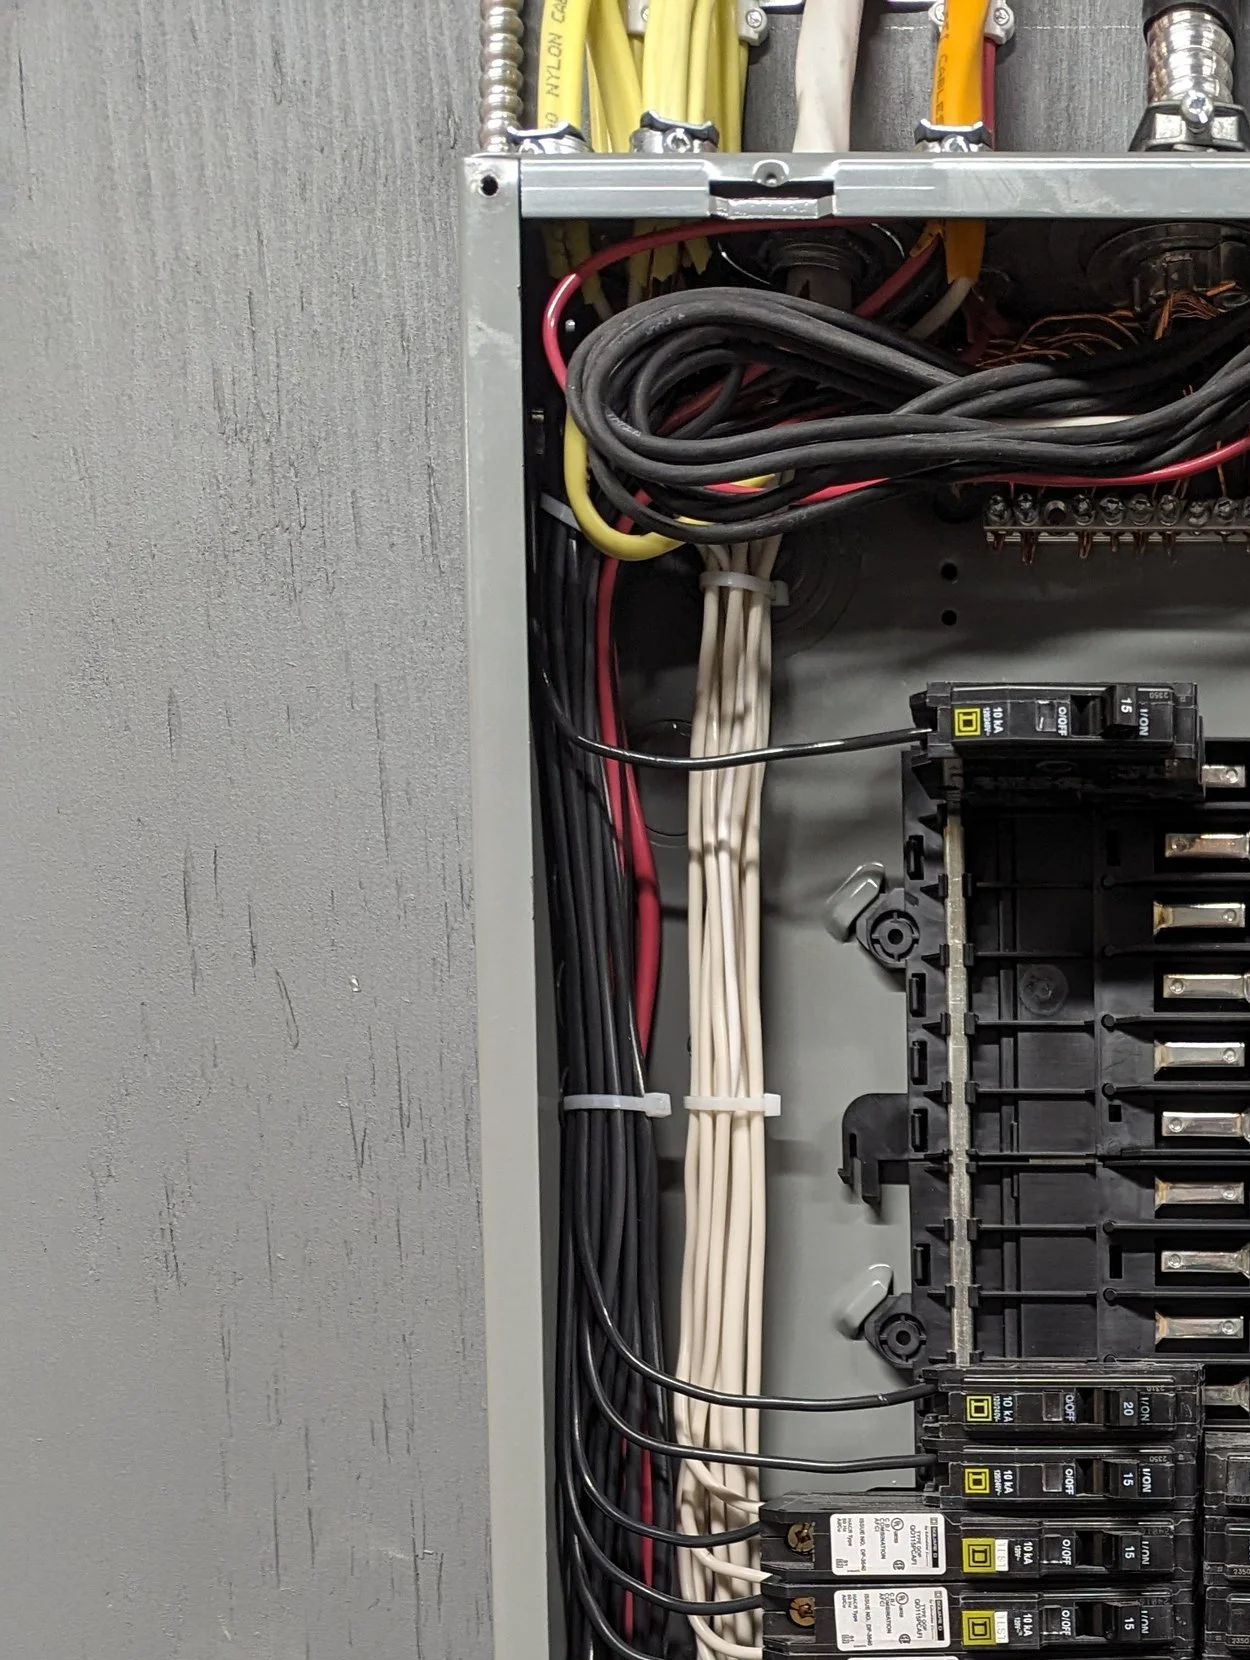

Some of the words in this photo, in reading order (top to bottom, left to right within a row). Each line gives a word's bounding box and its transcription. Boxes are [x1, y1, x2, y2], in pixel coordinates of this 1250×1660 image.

[545, 33, 563, 97] NYLON
[1121, 698, 1132, 713] 15
[1123, 1402, 1134, 1416] 20
[1123, 1472, 1133, 1486] 15
[1125, 1546, 1134, 1559] 15
[1124, 1617, 1134, 1630] 15
